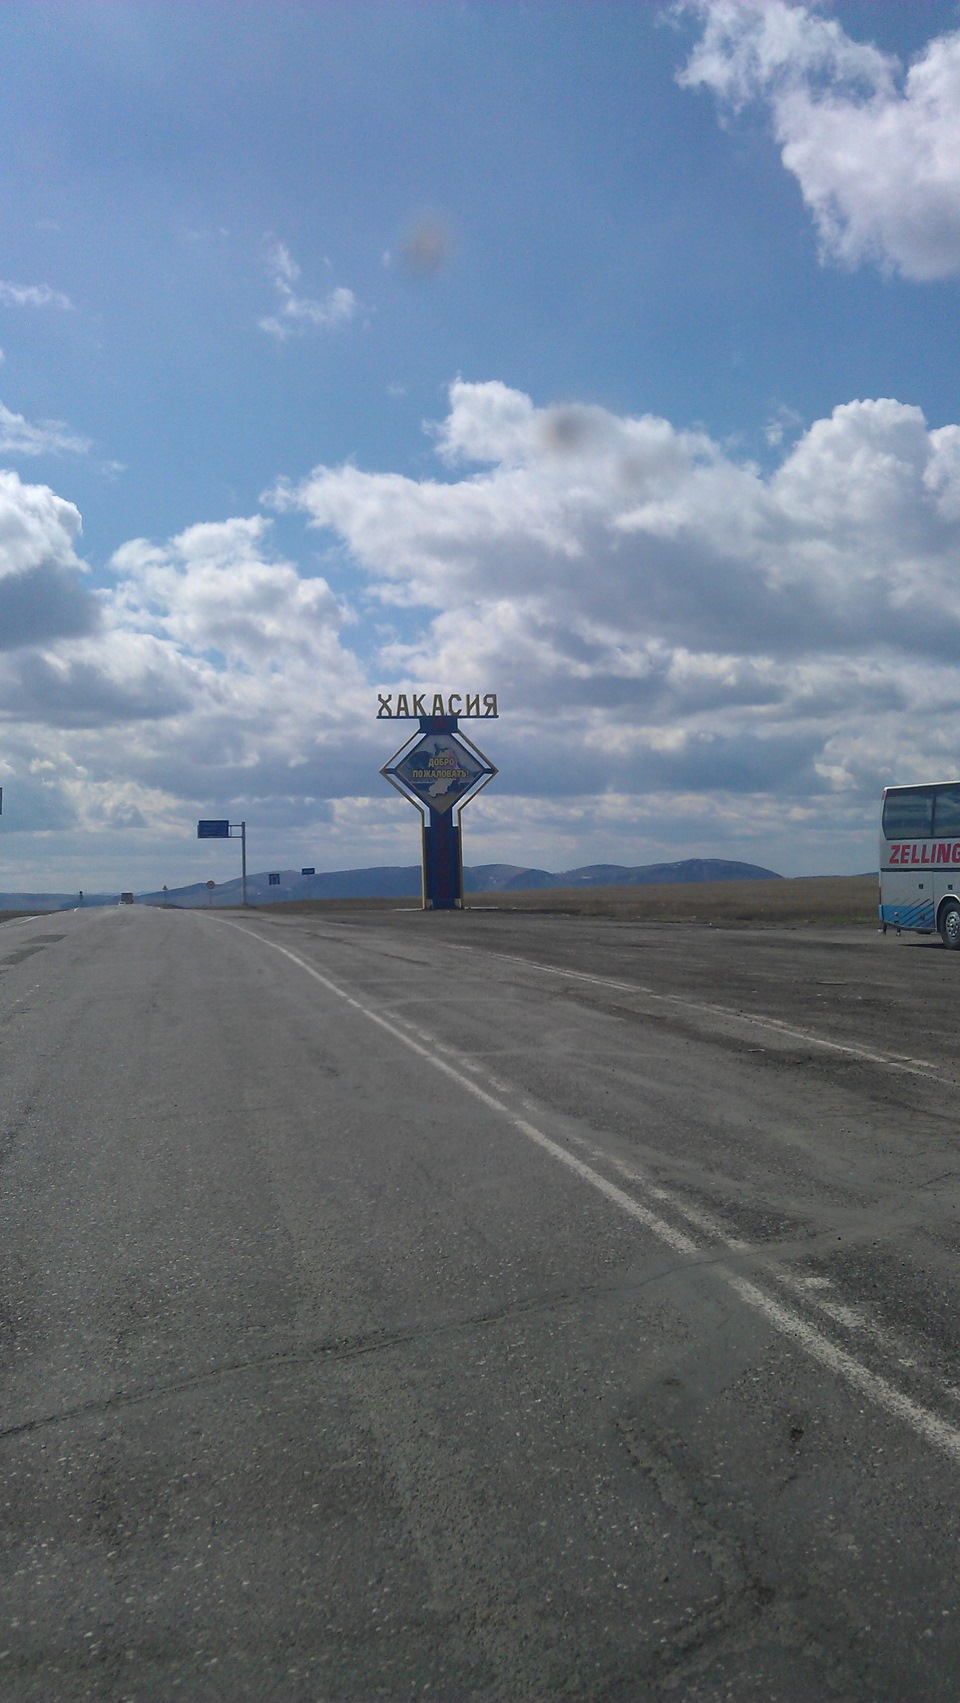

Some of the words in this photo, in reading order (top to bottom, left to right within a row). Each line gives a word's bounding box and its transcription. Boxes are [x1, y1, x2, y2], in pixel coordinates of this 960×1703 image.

[377, 694, 498, 717] ХАКАСИЯ
[428, 757, 455, 768] ДОБРО
[412, 769, 469, 778] ПОЖАЛОВАТЬ!
